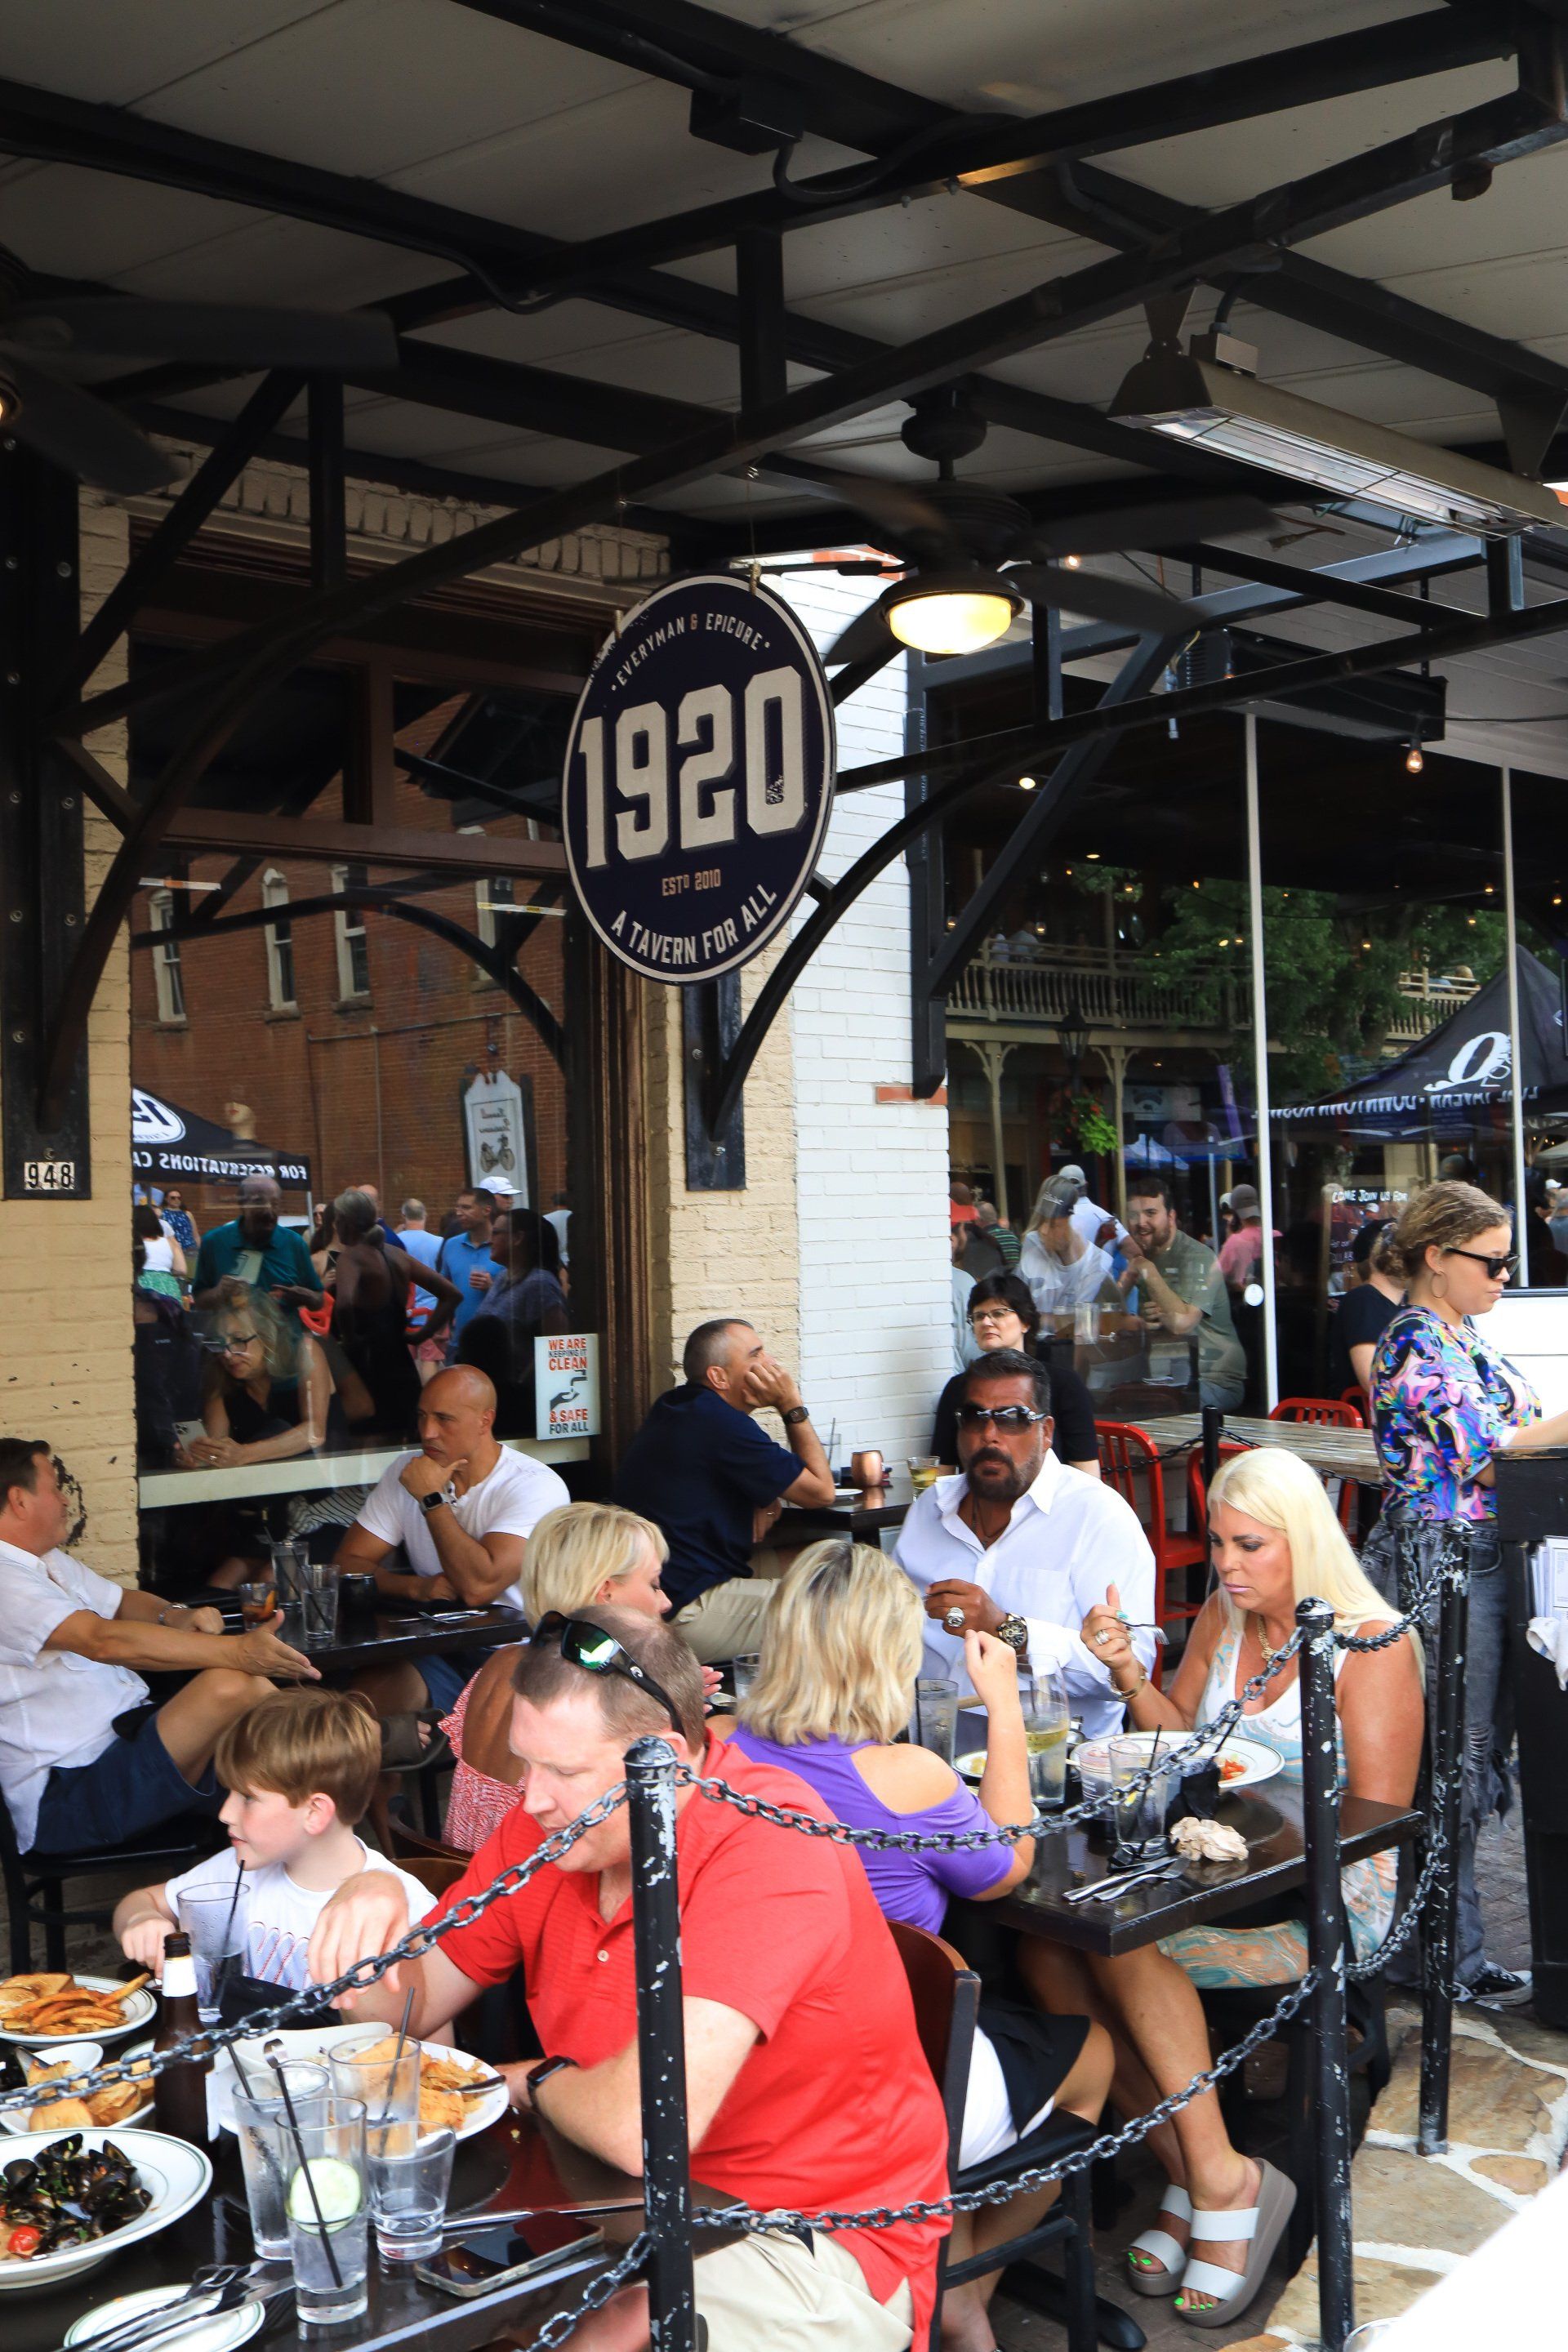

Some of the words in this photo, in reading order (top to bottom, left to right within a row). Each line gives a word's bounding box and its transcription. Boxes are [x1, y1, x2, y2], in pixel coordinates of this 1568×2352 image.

[616, 617, 685, 686] EVERYMAN
[690, 613, 698, 630] &
[705, 612, 764, 651] EPICURE
[578, 666, 807, 869] 1920
[695, 868, 721, 891] 2010
[610, 910, 627, 938] A
[628, 920, 697, 964] TAVERN
[702, 917, 739, 960] FOR
[740, 884, 777, 933] ALL
[28, 1164, 71, 1188] 948
[549, 1339, 564, 1350] WE
[567, 1338, 586, 1349] ARE
[549, 1356, 587, 1371] CLEAN
[550, 1410, 557, 1423] &
[559, 1409, 588, 1423] SAFE
[550, 1423, 569, 1435] FOR
[572, 1422, 589, 1432] ALL
